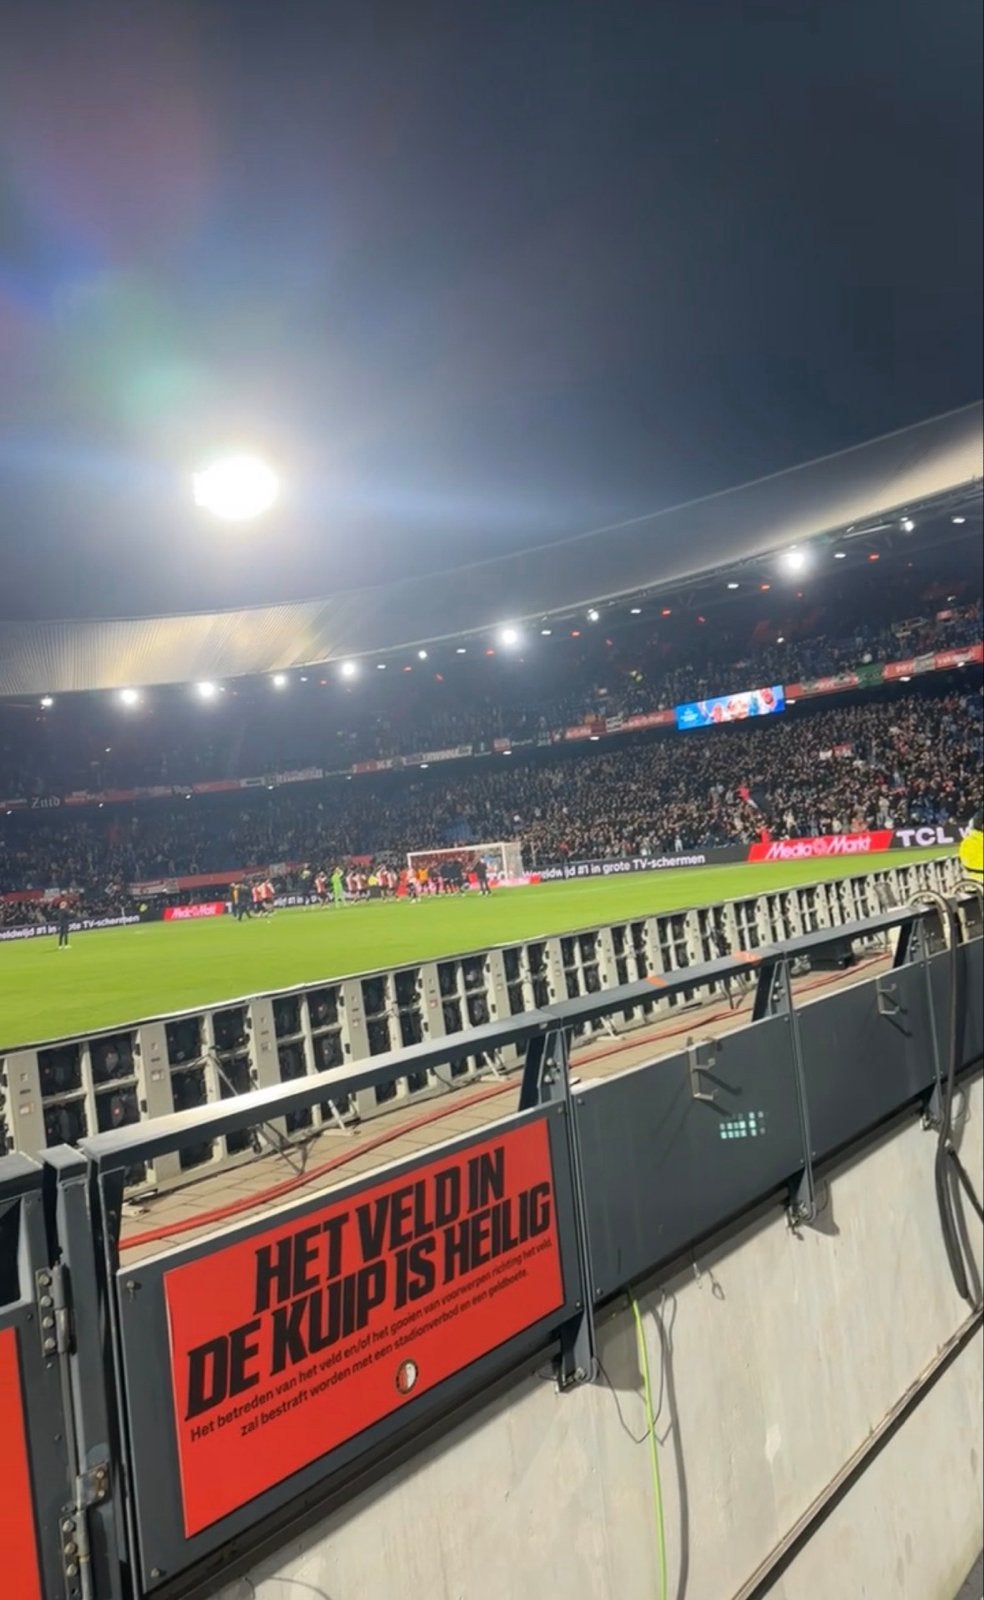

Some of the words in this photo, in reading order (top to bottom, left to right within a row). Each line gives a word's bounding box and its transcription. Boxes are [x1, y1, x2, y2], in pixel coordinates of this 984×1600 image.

[591, 861, 601, 873] in
[603, 860, 630, 875] grote
[633, 853, 705, 869] TV-schermen
[896, 827, 955, 847] TCL
[185, 1317, 261, 1421] DE
[269, 1259, 387, 1376] KUIP
[394, 1235, 436, 1311] IS
[442, 1181, 551, 1286] HEILIG
[253, 1212, 349, 1315] HET
[355, 1165, 461, 1262] VELD
[467, 1146, 505, 1214] IN
[190, 1420, 215, 1442] Het
[217, 1389, 274, 1428] betreden
[275, 1377, 298, 1396] van
[298, 1364, 318, 1383] het
[319, 1350, 342, 1372] veld
[343, 1333, 371, 1359] en/of
[372, 1326, 389, 1343] het
[390, 1309, 423, 1336] gooien
[423, 1299, 440, 1315] van
[441, 1271, 491, 1305] voorwerpen
[491, 1254, 522, 1277] richting
[522, 1246, 537, 1260] het
[241, 1416, 259, 1436] zal
[260, 1390, 308, 1425] bestraft
[310, 1367, 351, 1397] worden
[351, 1354, 372, 1373] met
[374, 1343, 393, 1360] een
[394, 1304, 459, 1349] stadionverbod
[460, 1300, 471, 1312] en
[472, 1291, 488, 1306] een
